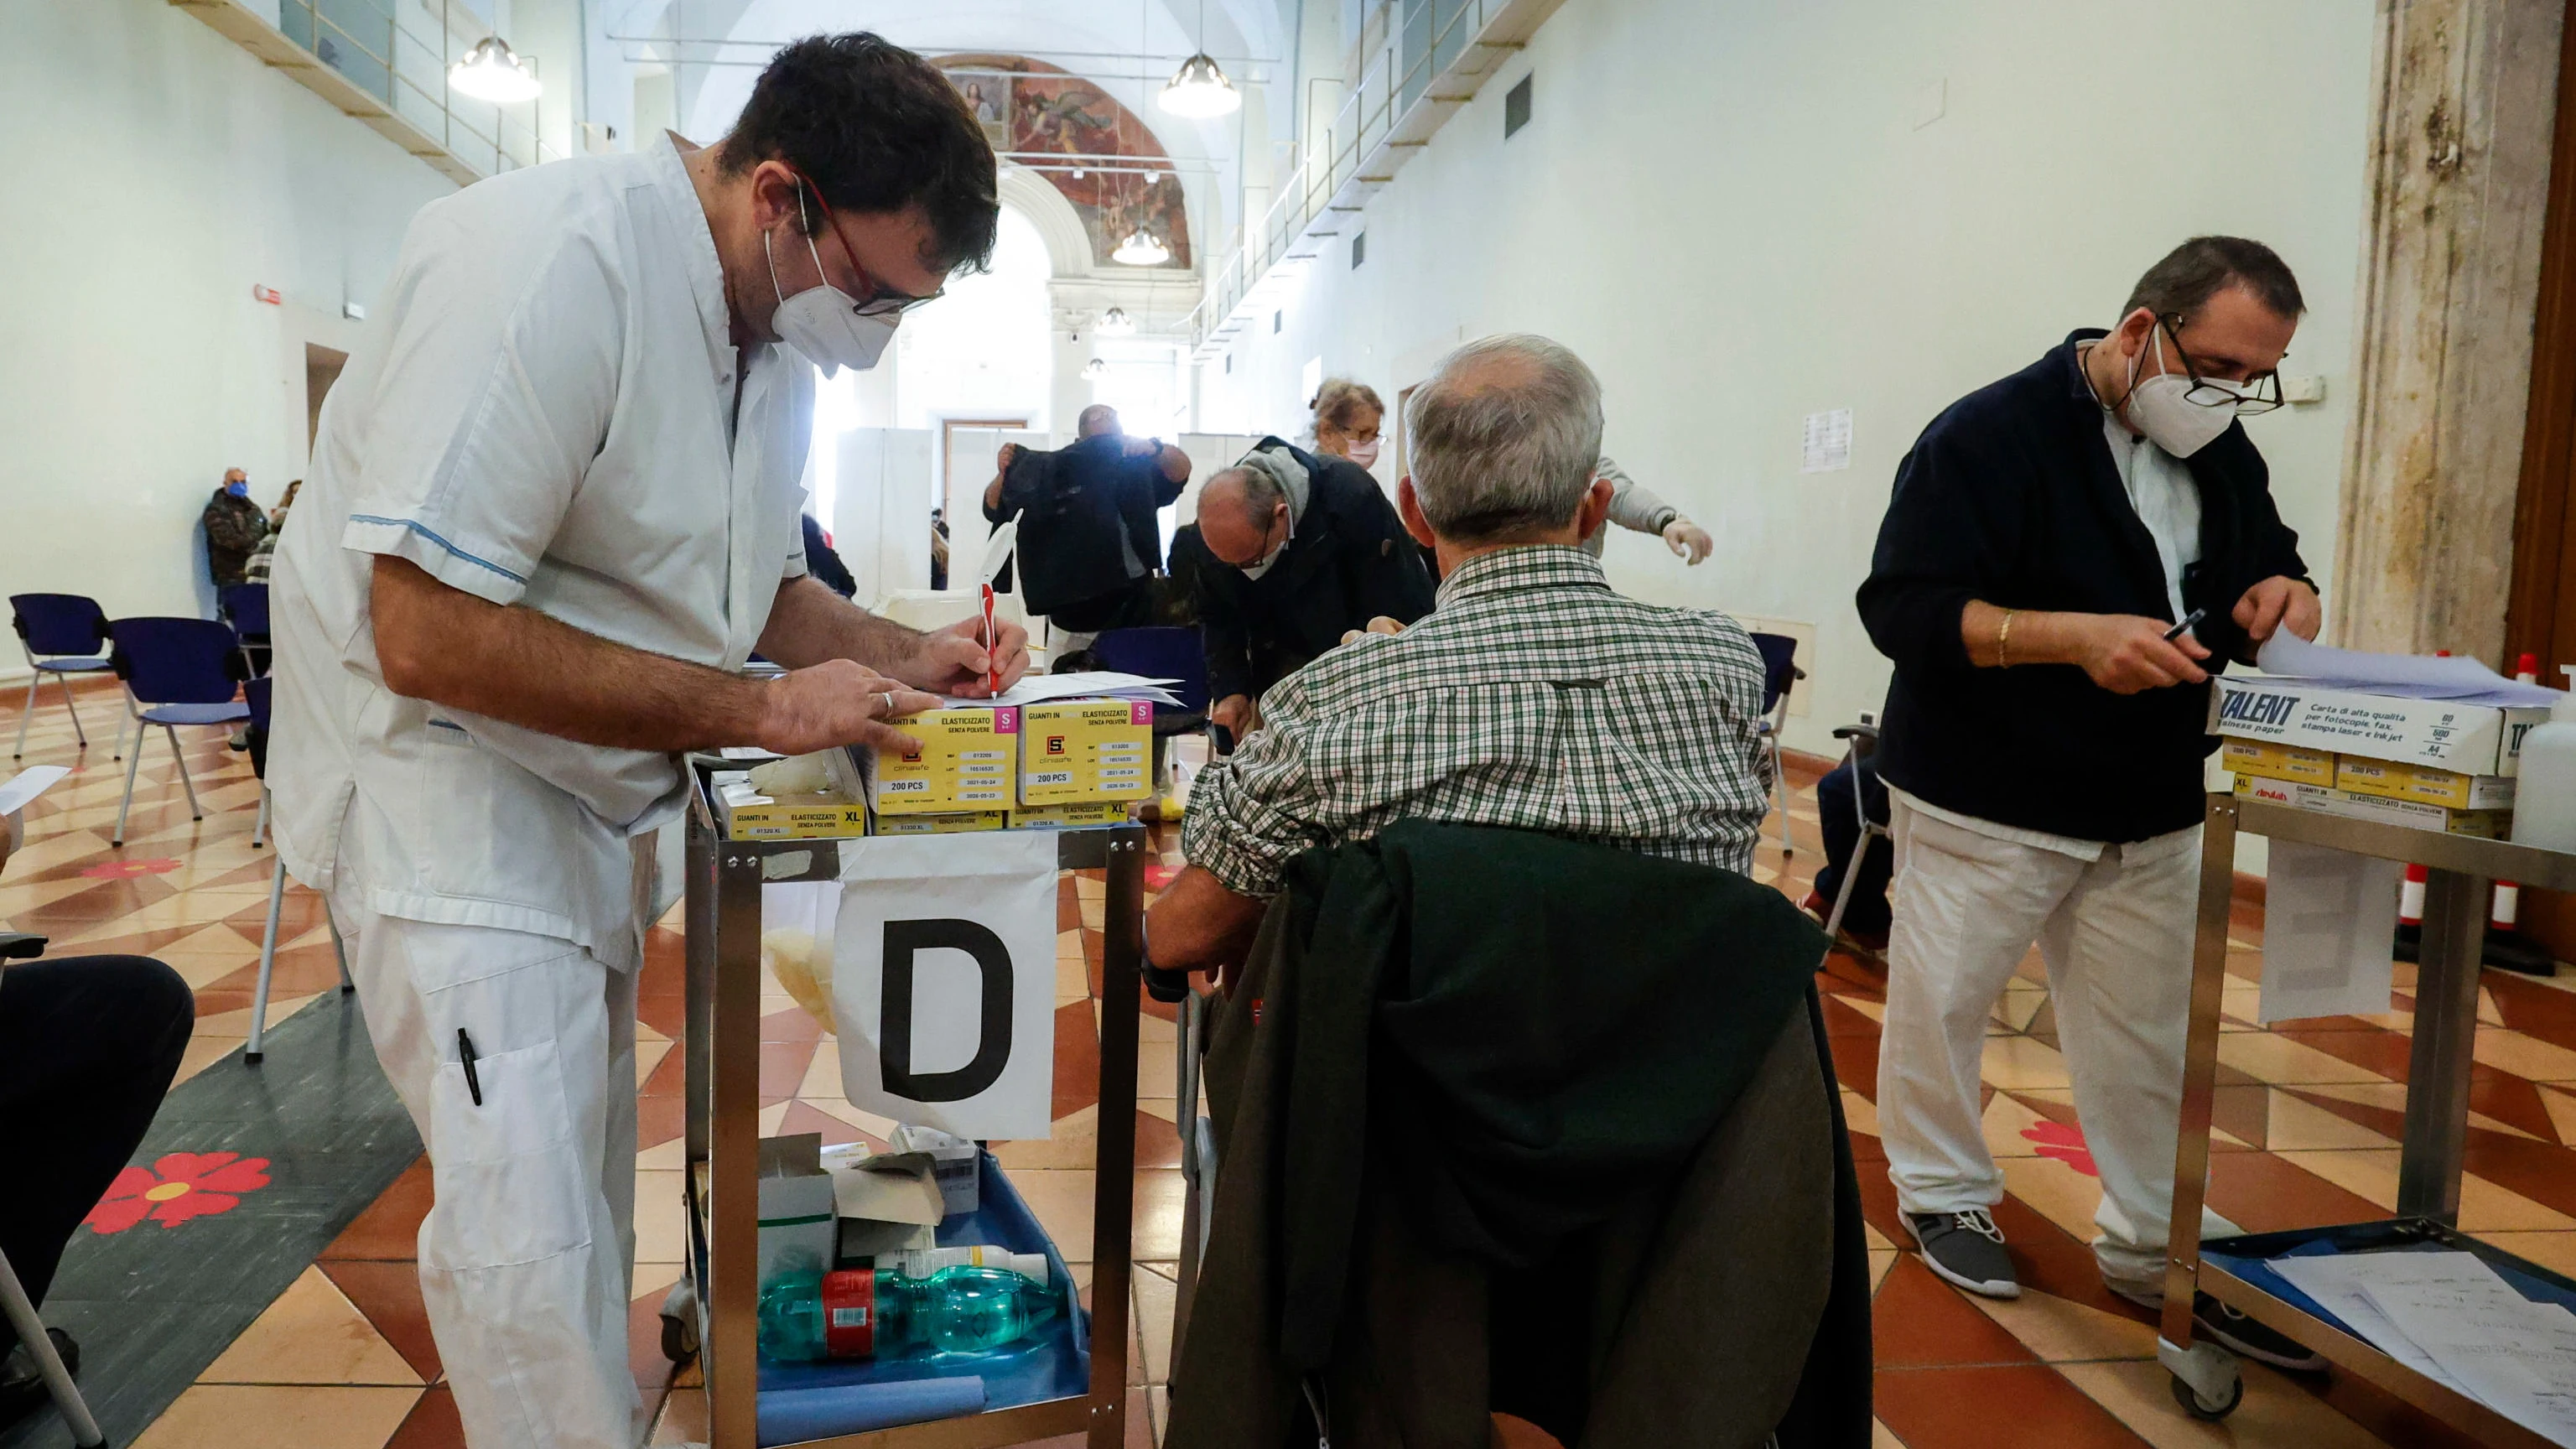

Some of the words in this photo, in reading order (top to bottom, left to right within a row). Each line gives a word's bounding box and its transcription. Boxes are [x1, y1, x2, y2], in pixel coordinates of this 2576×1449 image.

[1138, 705, 1147, 717] S
[2220, 689, 2301, 726] TALENT
[2310, 704, 2337, 714] Carta
[2340, 706, 2350, 714] di
[2350, 708, 2370, 717] alta
[942, 717, 990, 725] ELASTICIZZATO
[1001, 713, 1010, 724] S
[2305, 714, 2321, 723] per
[2254, 725, 2285, 735] paper
[2301, 723, 2336, 734] stampa
[2338, 728, 2362, 737] laser
[891, 782, 906, 791] 200
[908, 782, 923, 790] PCS
[2236, 778, 2248, 787] XL
[1111, 803, 1125, 813] XL
[845, 811, 860, 822] XL
[880, 918, 1014, 1103] D
